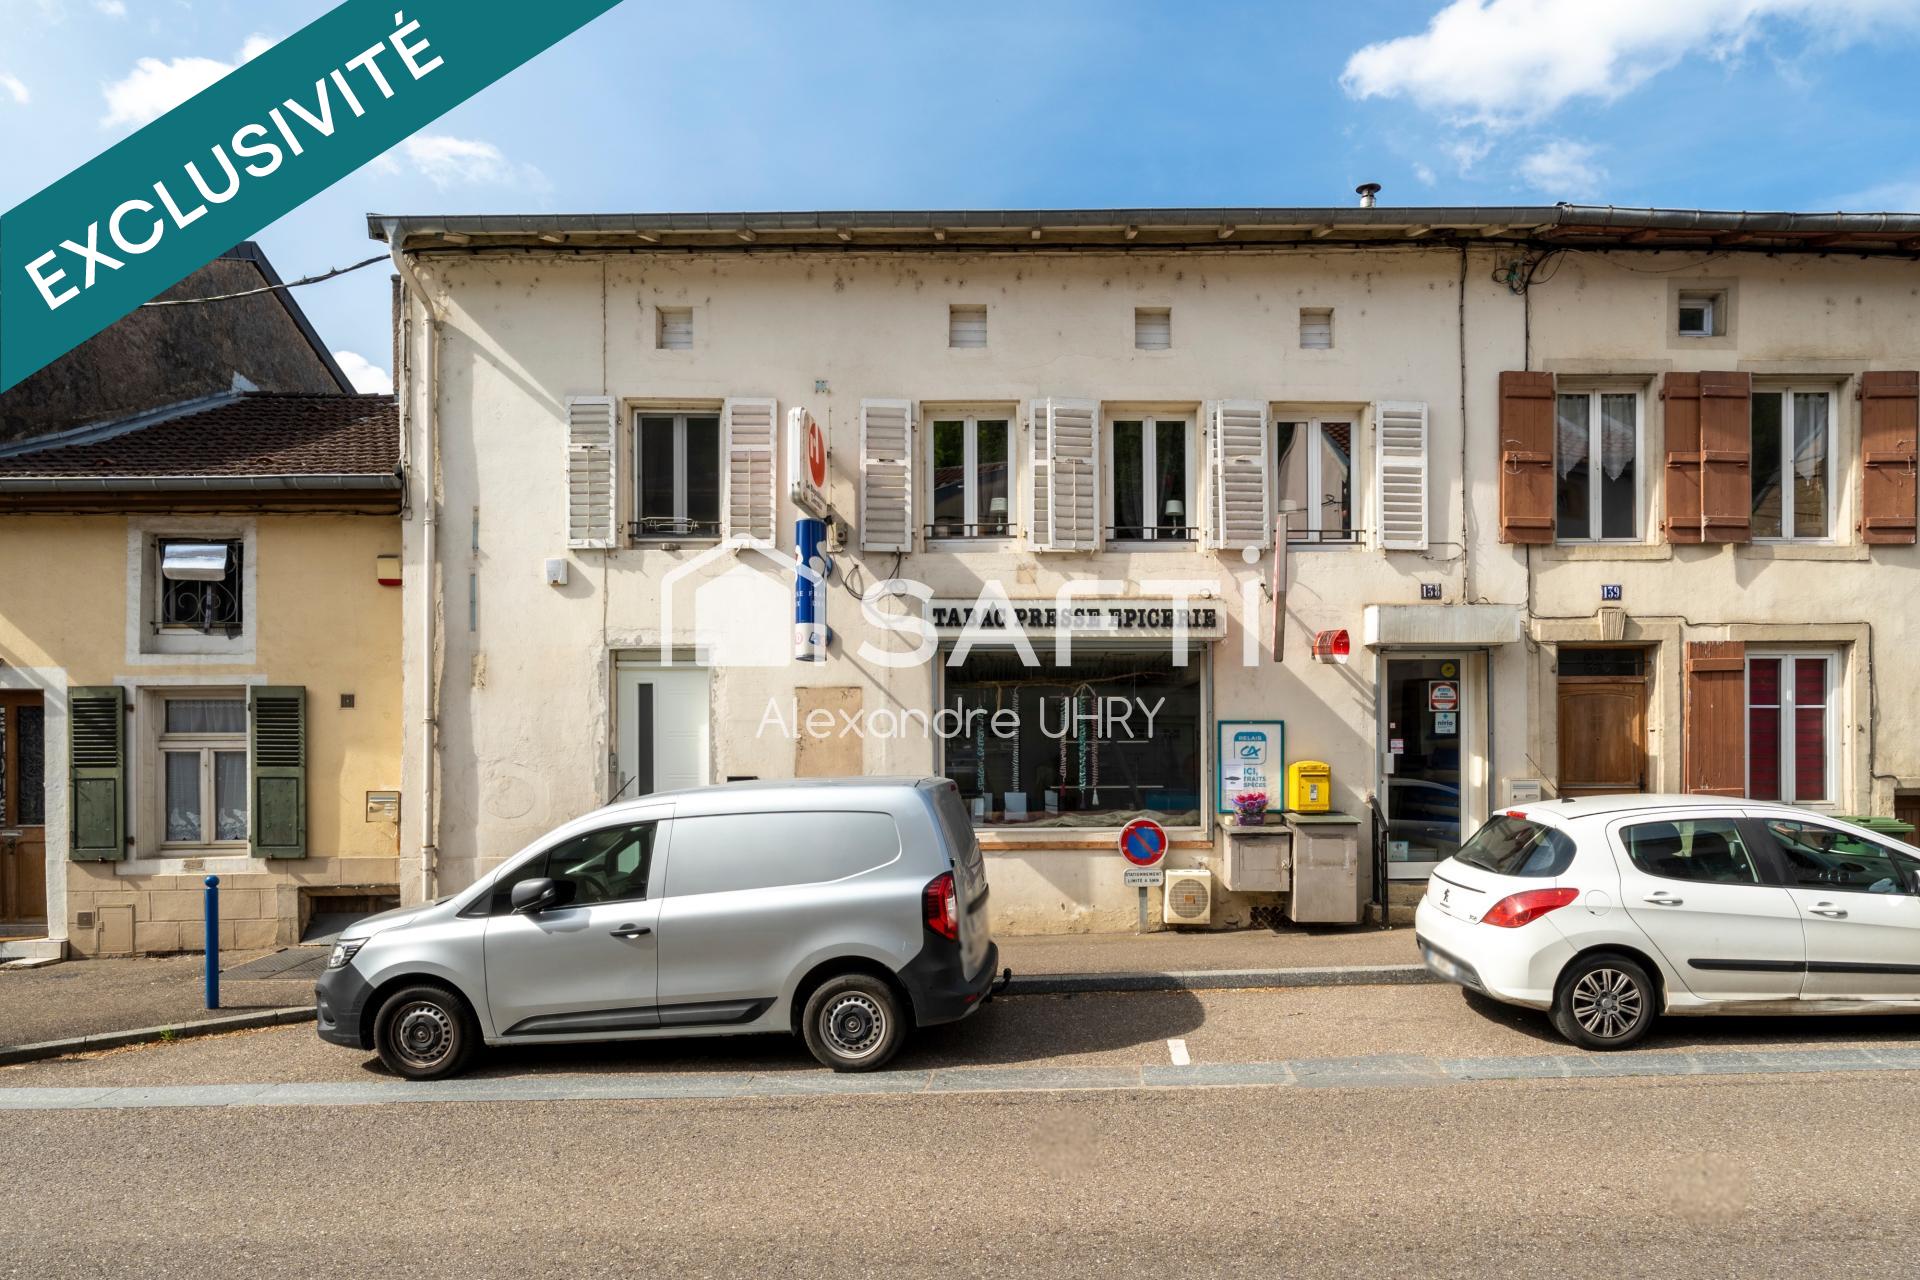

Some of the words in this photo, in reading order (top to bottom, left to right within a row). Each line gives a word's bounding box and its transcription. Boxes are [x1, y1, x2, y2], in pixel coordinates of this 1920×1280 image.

[1422, 584, 1440, 598] 138
[1603, 586, 1620, 598] 139
[932, 607, 1006, 628] TABAC
[1015, 607, 1101, 629] PRESSE
[1108, 608, 1217, 629] EPICERIE
